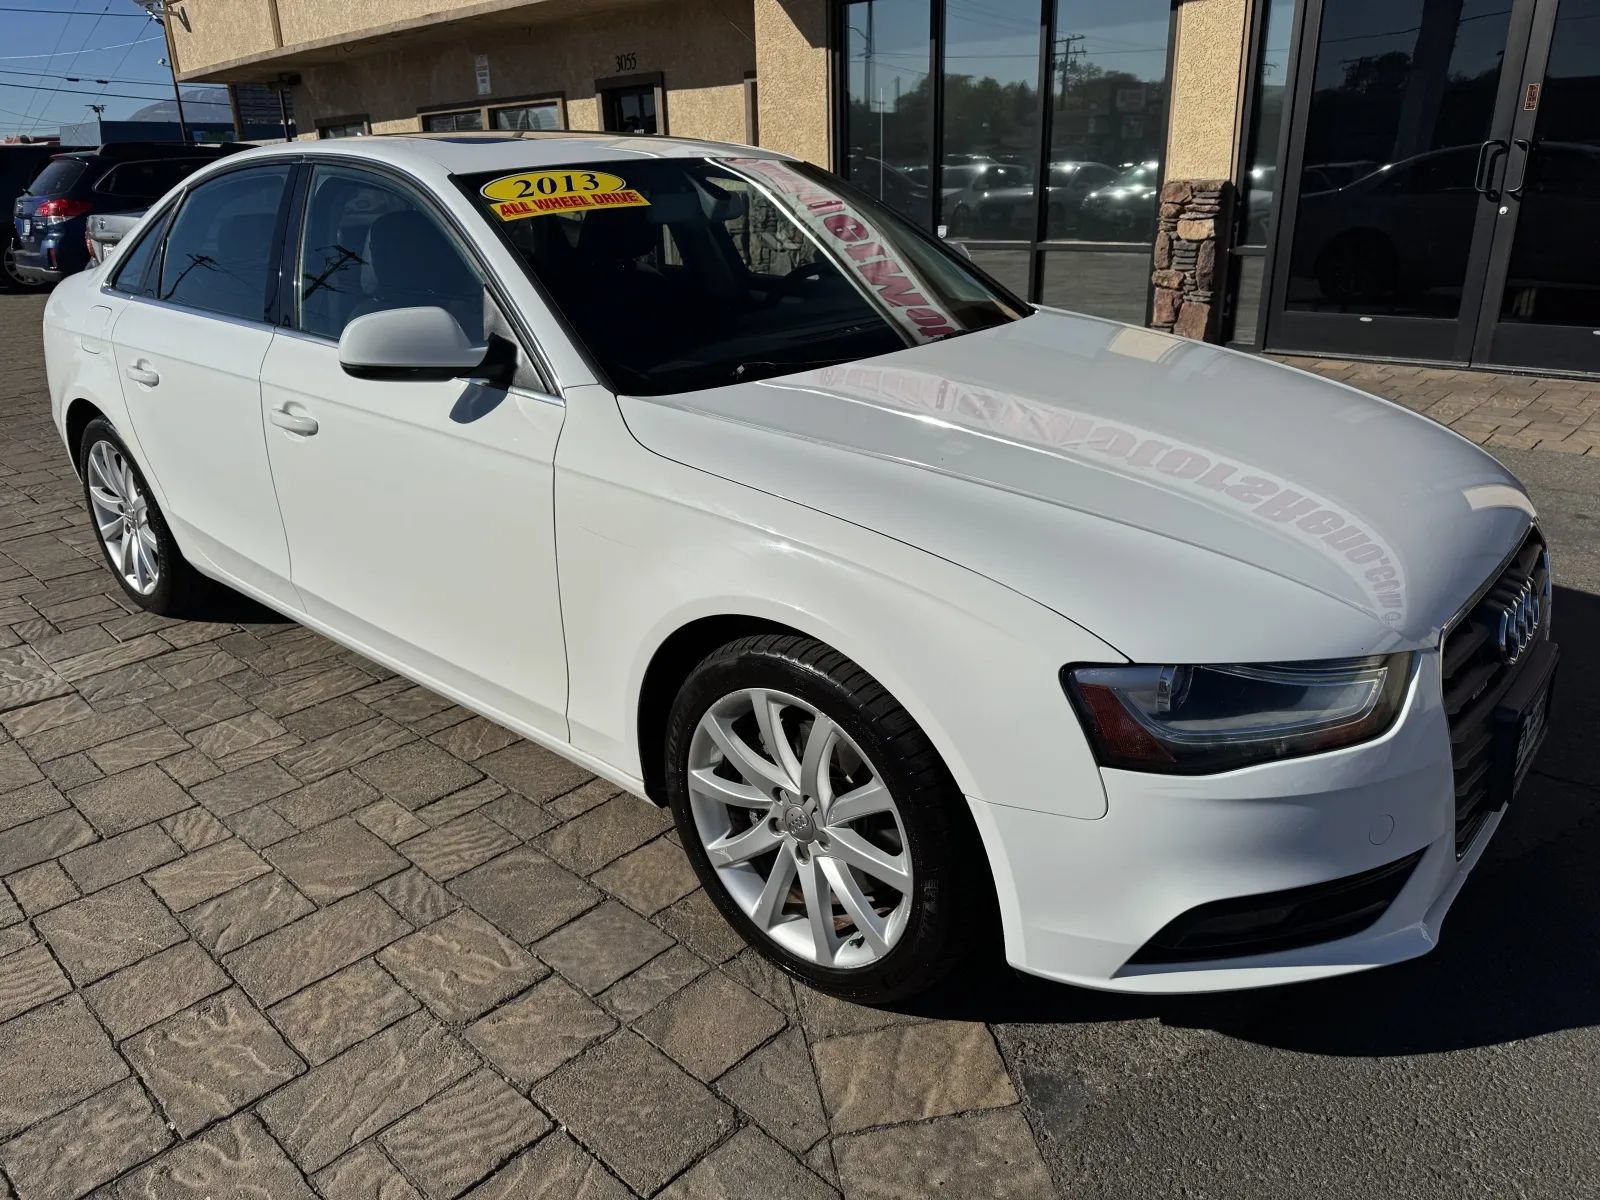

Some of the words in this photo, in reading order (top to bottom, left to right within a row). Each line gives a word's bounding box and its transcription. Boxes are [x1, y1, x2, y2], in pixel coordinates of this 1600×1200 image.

[615, 52, 637, 72] 3055
[512, 173, 600, 199] 2013
[499, 199, 533, 217] ALL
[532, 195, 590, 212] WHEEL
[590, 191, 642, 206] DRIVE
